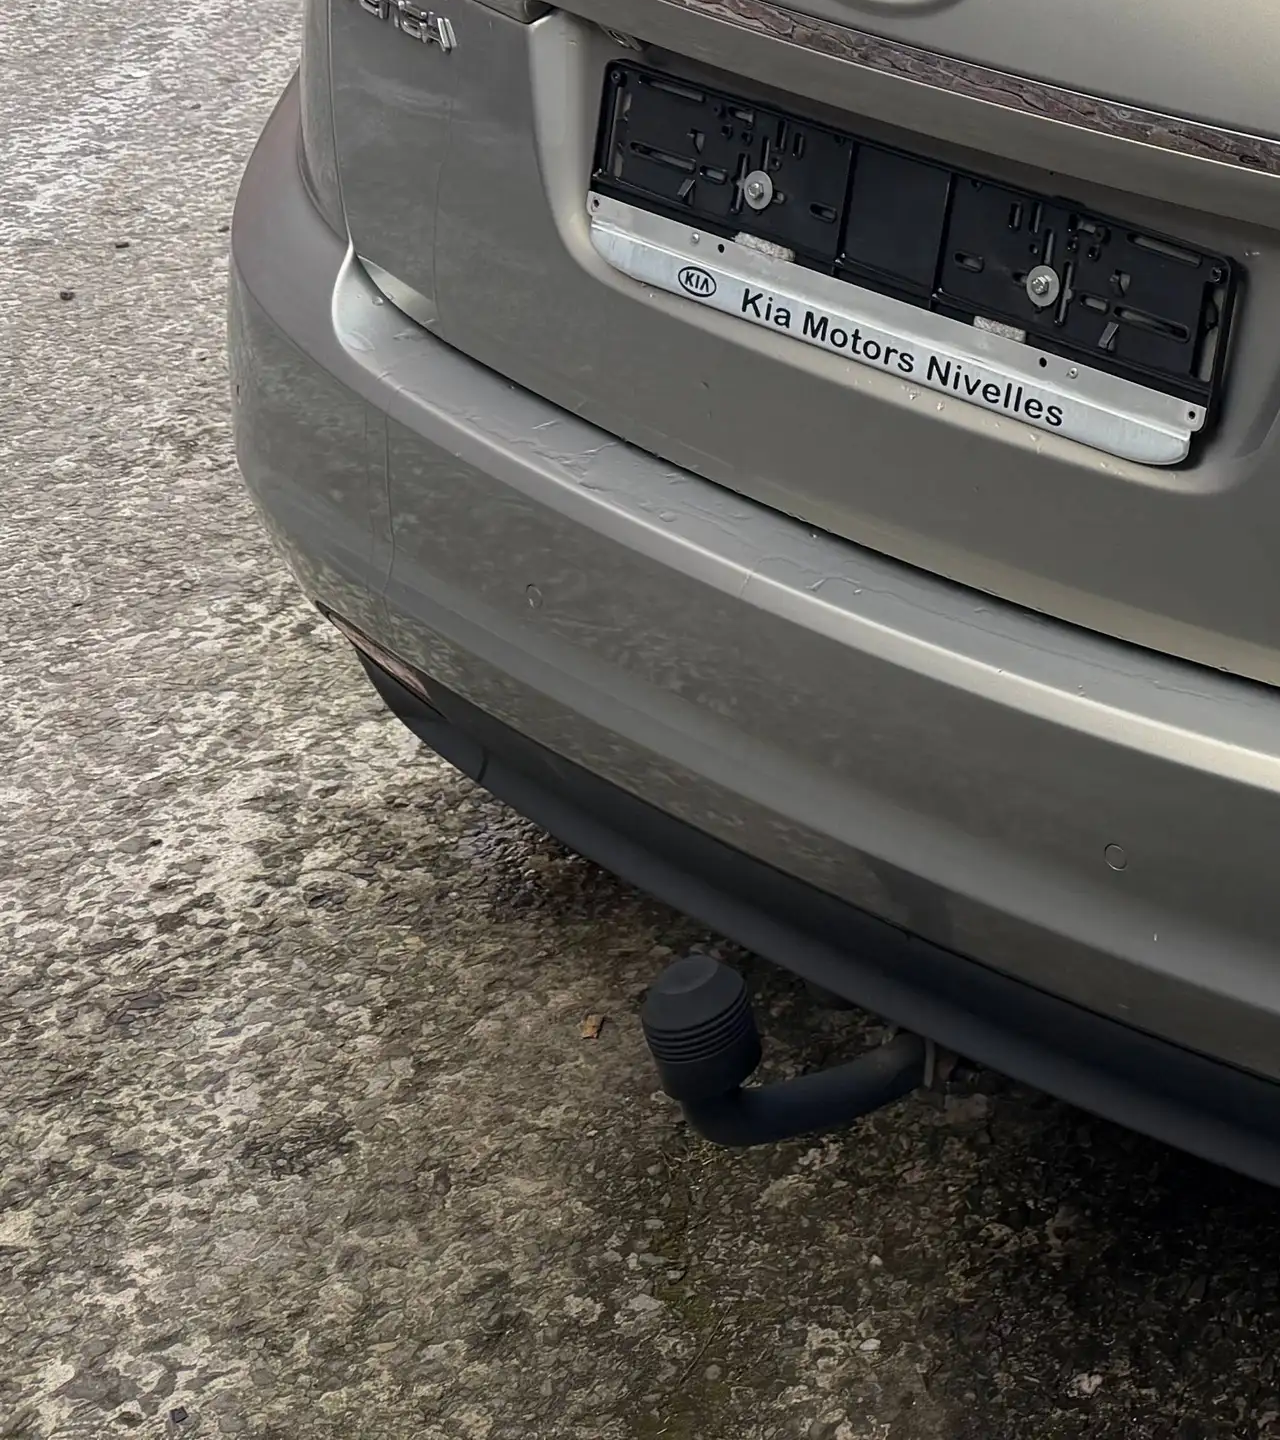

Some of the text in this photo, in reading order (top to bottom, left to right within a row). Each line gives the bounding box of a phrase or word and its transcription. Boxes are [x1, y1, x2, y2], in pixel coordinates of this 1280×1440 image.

[684, 270, 710, 293] KIA
[741, 287, 1063, 427] Kia Motors Nivelles
